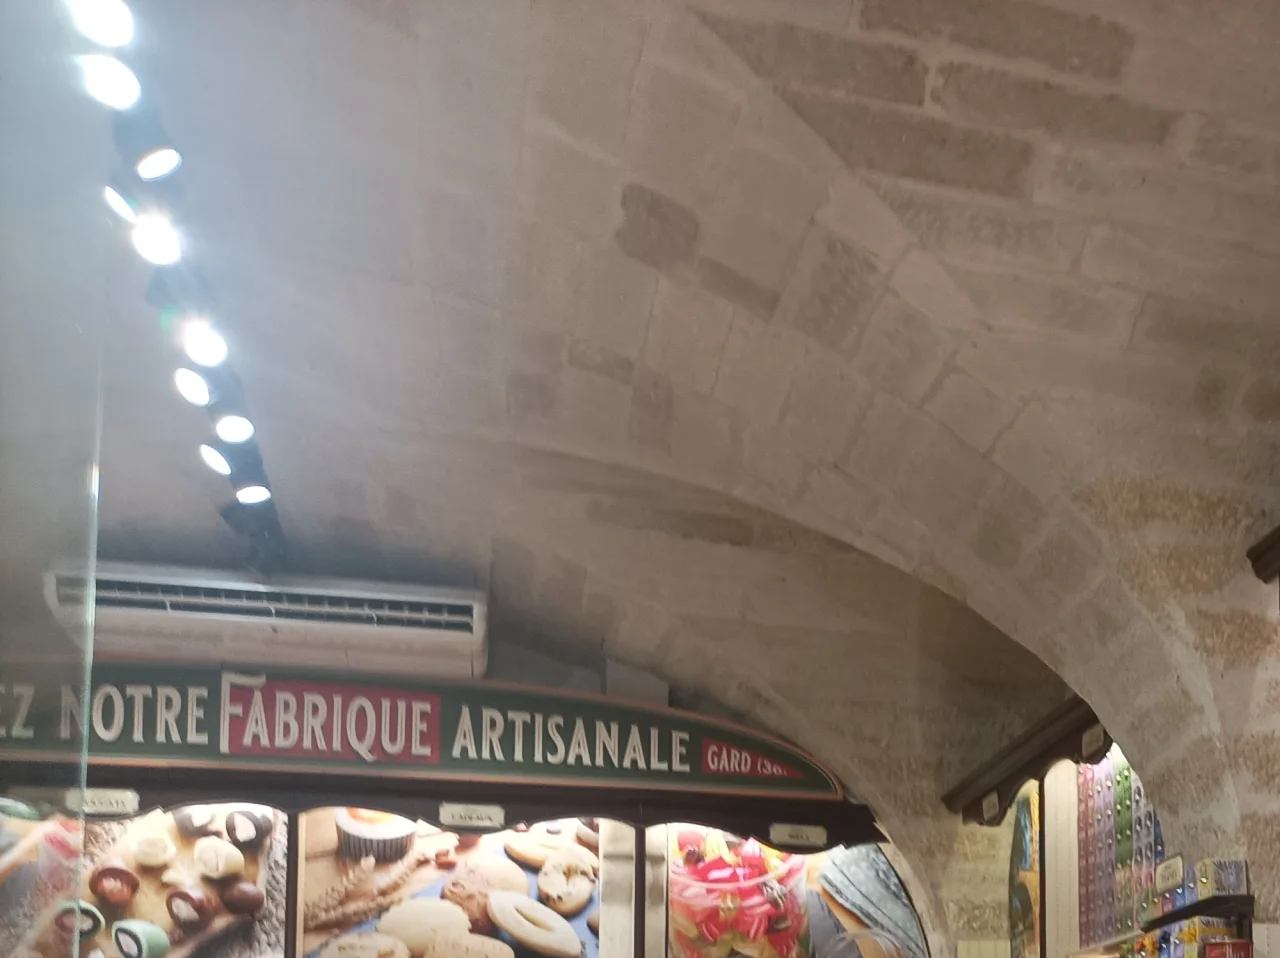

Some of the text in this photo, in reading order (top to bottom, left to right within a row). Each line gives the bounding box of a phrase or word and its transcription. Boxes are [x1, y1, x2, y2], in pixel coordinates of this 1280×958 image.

[60, 683, 209, 746] NOTRE
[219, 671, 433, 763] FABRIQUE
[451, 704, 692, 773] ARTISANALE
[707, 745, 752, 774] GARD
